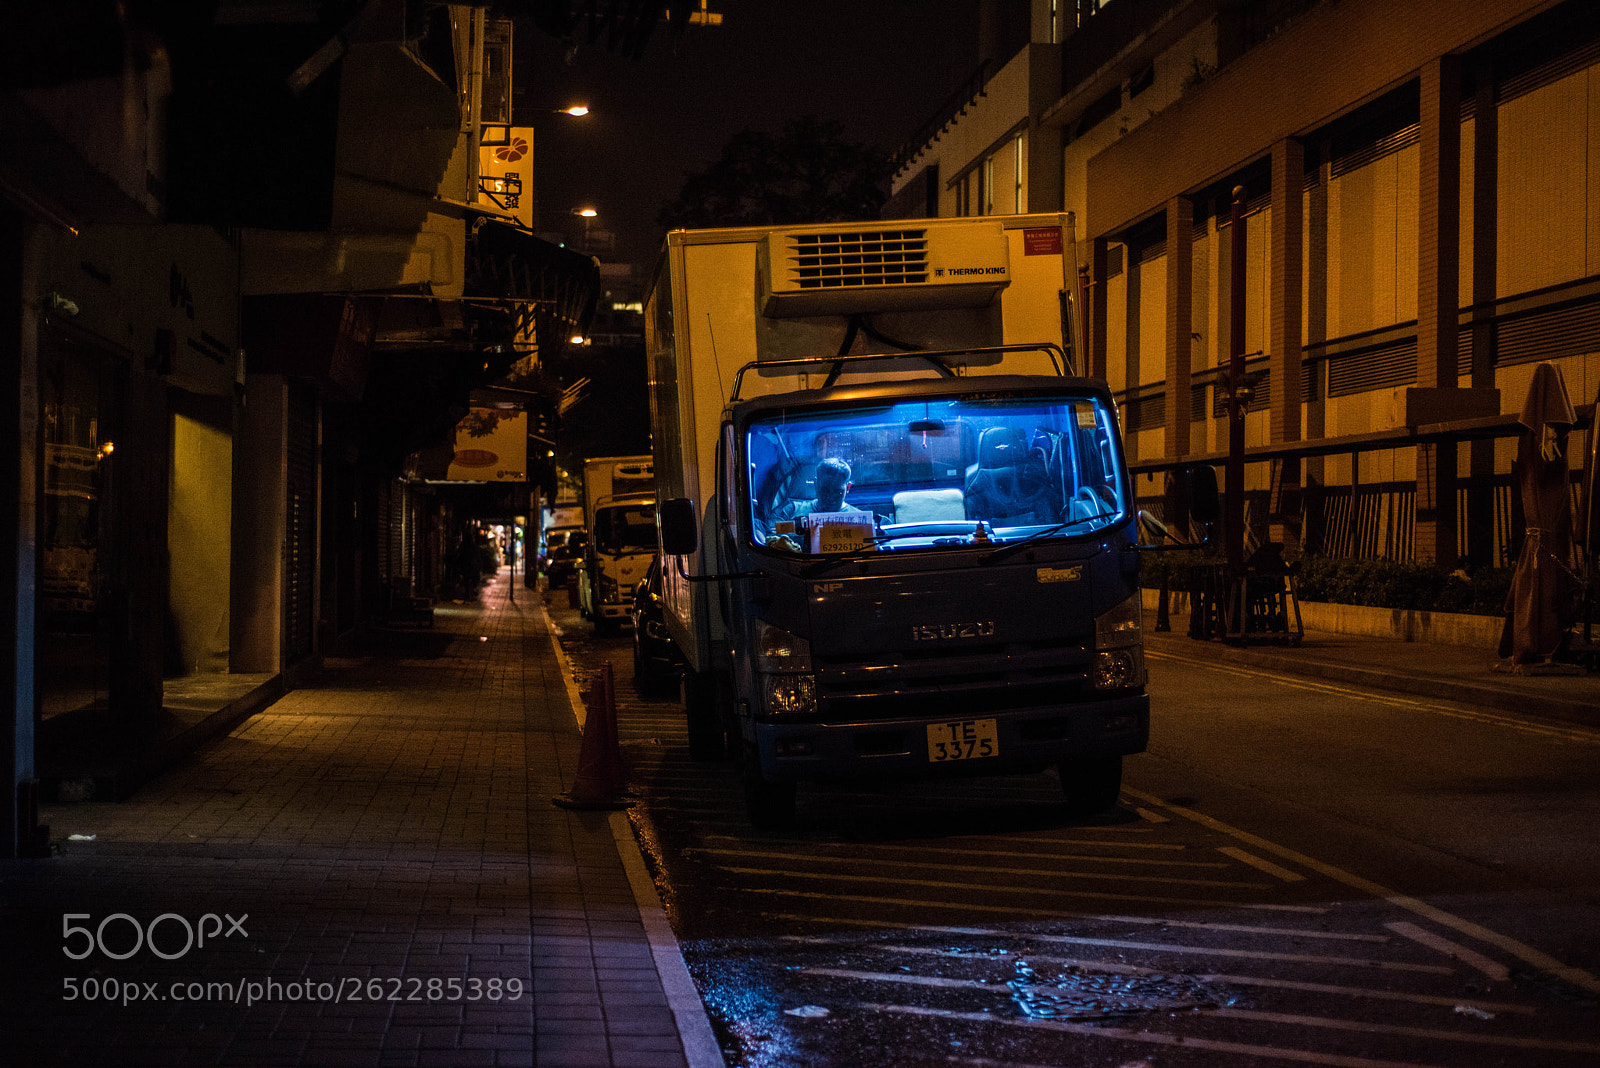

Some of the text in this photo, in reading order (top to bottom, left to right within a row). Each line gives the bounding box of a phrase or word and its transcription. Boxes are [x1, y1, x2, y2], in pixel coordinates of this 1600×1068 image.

[948, 267, 1006, 276] THERMO KING
[912, 621, 995, 641] ISUZU
[947, 721, 977, 740] TE
[935, 738, 993, 760] 3375
